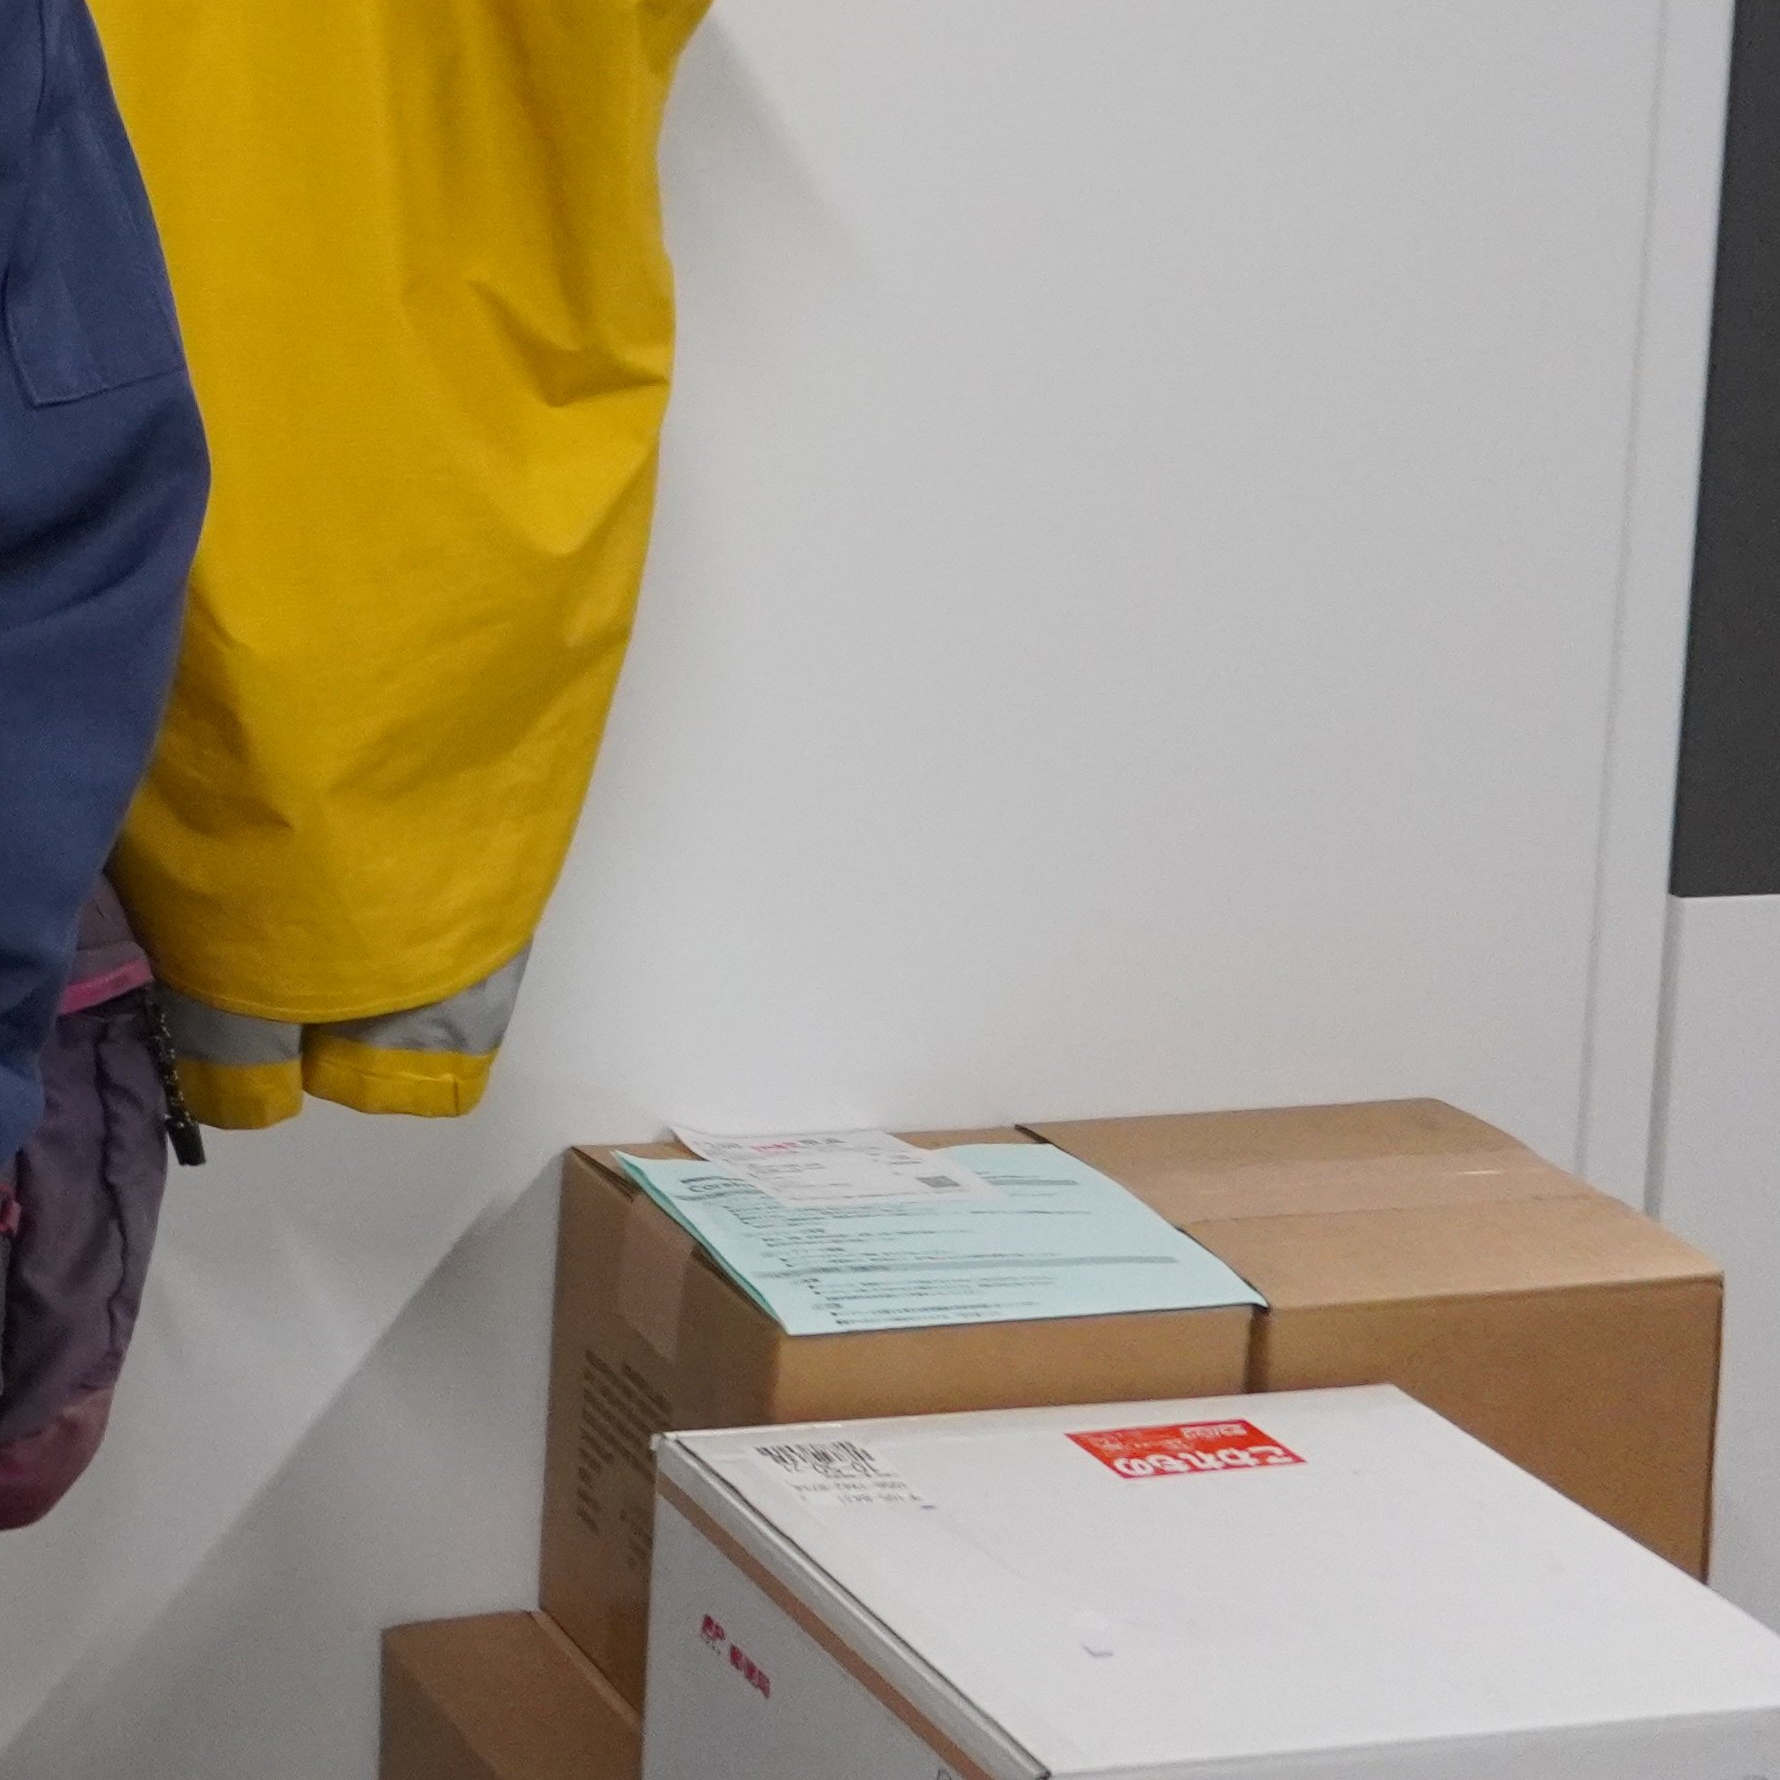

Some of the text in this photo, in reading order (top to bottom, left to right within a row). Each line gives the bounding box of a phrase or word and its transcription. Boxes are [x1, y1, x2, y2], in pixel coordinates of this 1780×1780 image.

[1112, 1445, 1292, 1477] こわれもの
